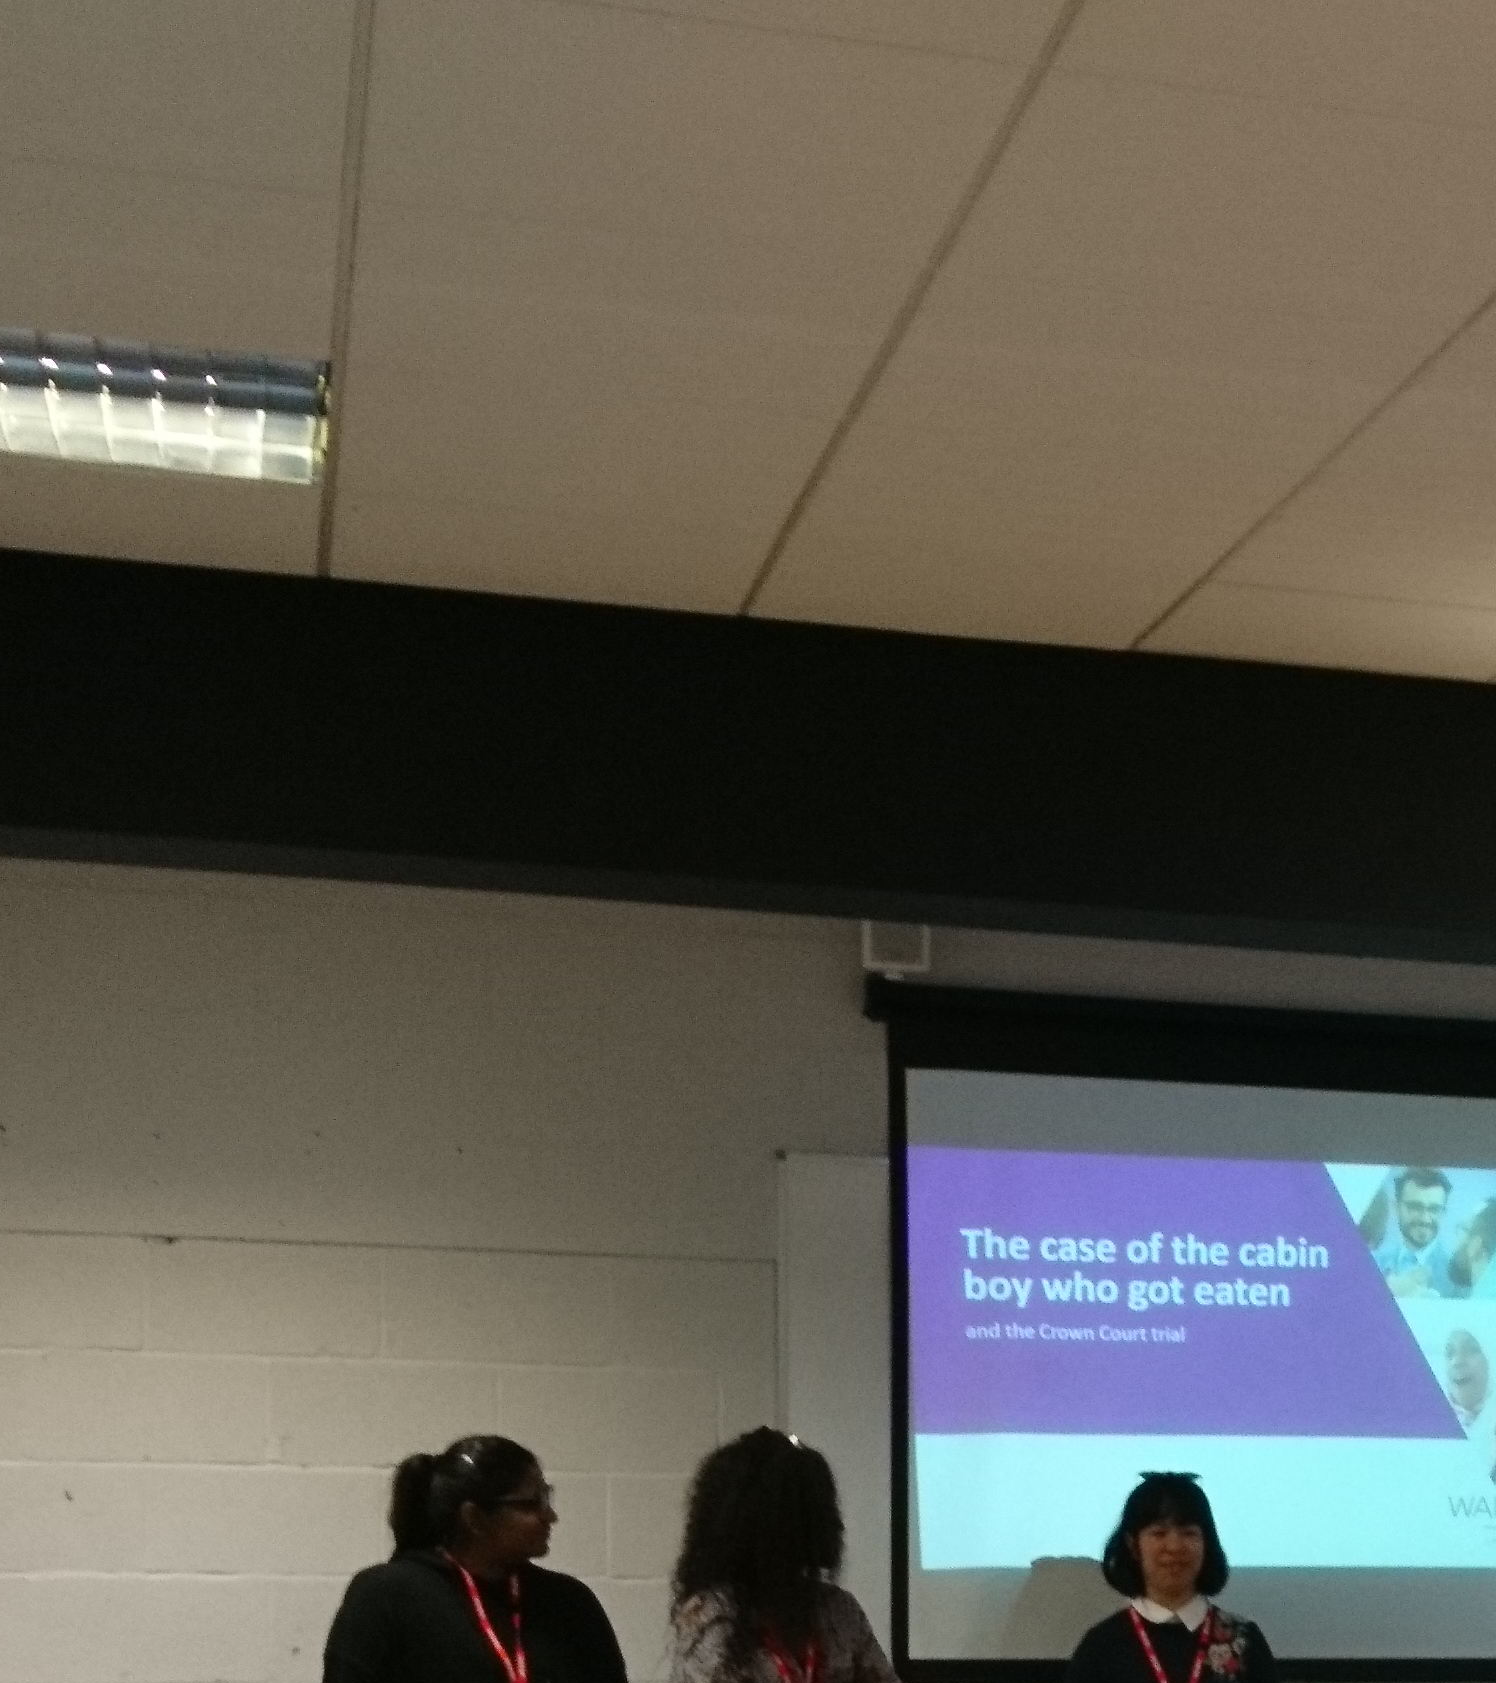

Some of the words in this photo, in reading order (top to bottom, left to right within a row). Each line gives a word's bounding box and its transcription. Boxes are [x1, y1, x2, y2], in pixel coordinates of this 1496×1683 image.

[959, 1228, 1030, 1260] The
[1039, 1235, 1117, 1263] case
[1126, 1231, 1164, 1264] of
[1171, 1233, 1230, 1267] the
[1238, 1235, 1329, 1269] cabin
[963, 1267, 1033, 1309] boy
[1041, 1269, 1119, 1304] who
[1127, 1275, 1185, 1312] got
[1193, 1278, 1291, 1306] eaten
[965, 1322, 1001, 1340] and
[1005, 1322, 1036, 1340] the
[1038, 1323, 1095, 1341] Crown
[1098, 1324, 1147, 1342] Court
[1151, 1325, 1186, 1343] trial
